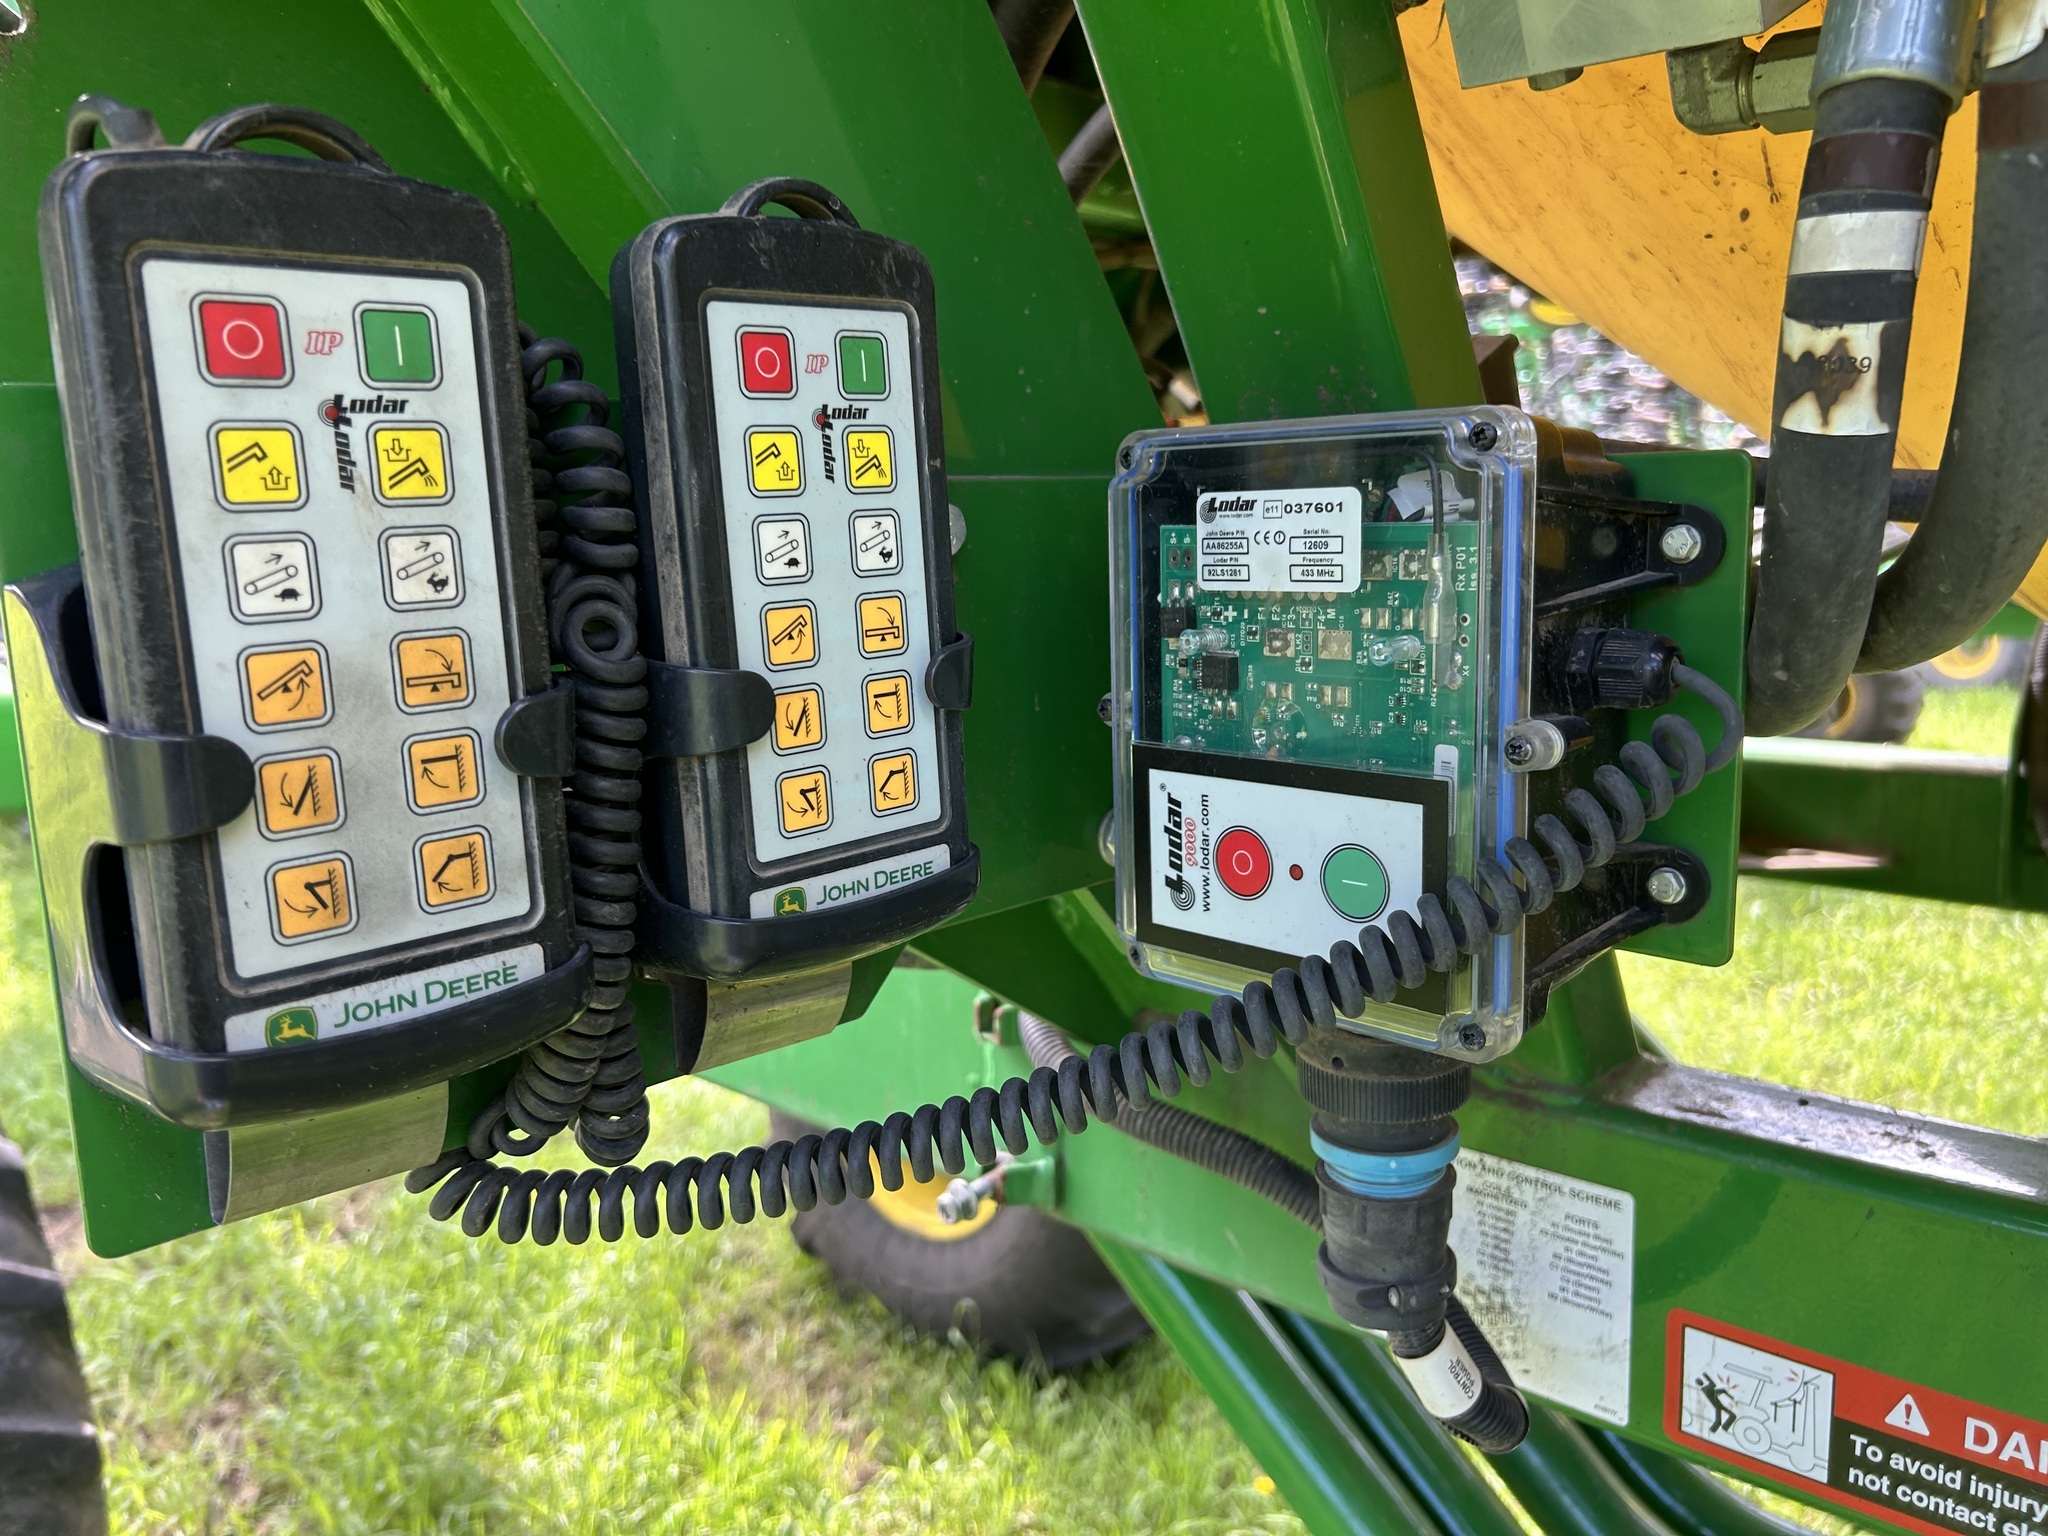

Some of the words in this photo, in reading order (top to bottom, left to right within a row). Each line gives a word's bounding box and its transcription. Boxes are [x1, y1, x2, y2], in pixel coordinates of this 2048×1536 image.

[305, 330, 343, 355] IP
[805, 354, 829, 374] IP
[334, 394, 409, 415] Lodar
[821, 404, 869, 420] Lodar
[332, 415, 357, 494] Lodar
[821, 420, 837, 484] Lodar
[1207, 497, 1257, 513] Lodar
[1284, 502, 1343, 514] 037601
[1205, 541, 1244, 550] AA86255A
[1302, 541, 1329, 550] 12609
[1302, 557, 1334, 565] Frequency
[1455, 547, 1466, 570] P01
[1207, 568, 1242, 577] 92LS1281
[1300, 569, 1315, 578] 433
[1317, 569, 1335, 578] MHz
[1455, 574, 1466, 591] Rx
[1184, 817, 1198, 867] 9000
[1200, 794, 1211, 912] www.lodar.com
[816, 877, 869, 906] JOHN
[874, 860, 935, 890] DEERE
[334, 990, 417, 1029] JOHN
[424, 964, 519, 1005] DEERE
[1481, 1164, 1505, 1178] AND
[1507, 1170, 1568, 1197] CONTROL
[1569, 1187, 1624, 1211] SCHEME
[1564, 1212, 1600, 1231] PORTS
[1447, 1359, 1474, 1400] CONTROL
[1454, 1355, 1476, 1387] POWER
[1850, 1433, 1883, 1464] To
[1889, 1452, 1962, 1491] avoid
[1969, 1475, 2048, 1523] injury
[1848, 1465, 1891, 1497] not
[1895, 1485, 1997, 1533] contact
